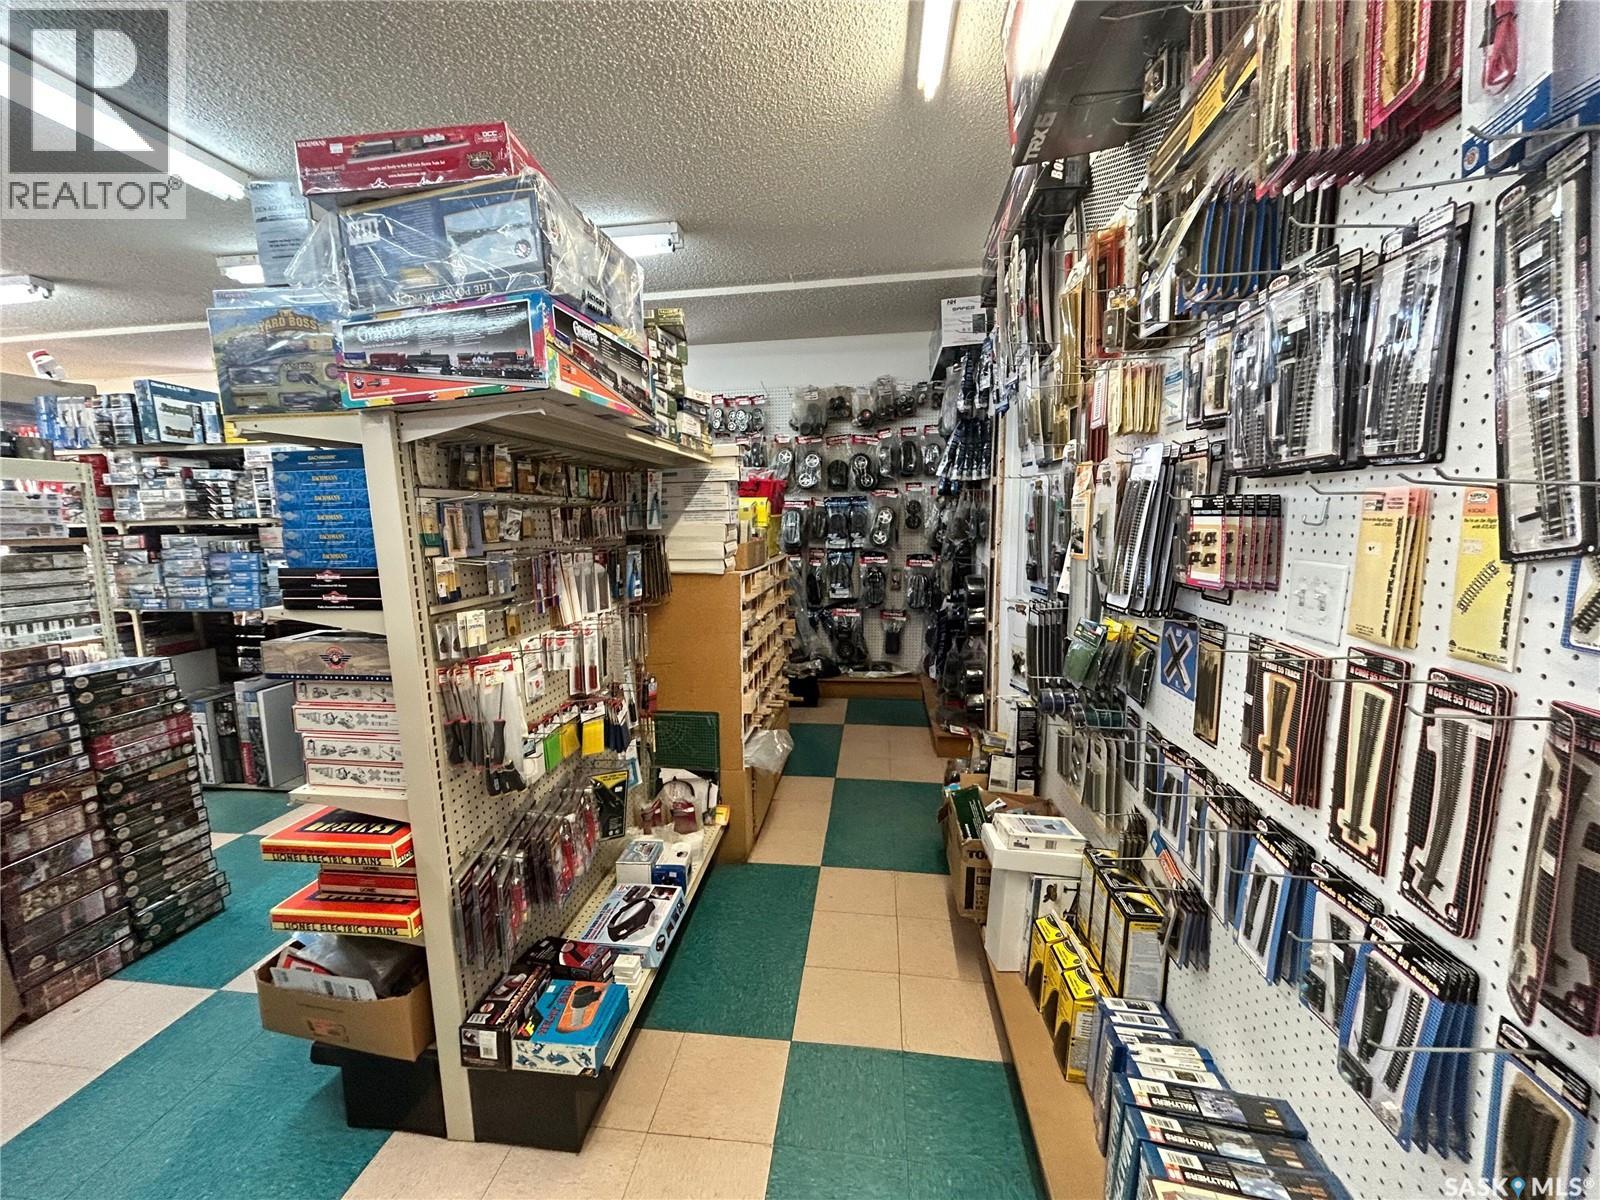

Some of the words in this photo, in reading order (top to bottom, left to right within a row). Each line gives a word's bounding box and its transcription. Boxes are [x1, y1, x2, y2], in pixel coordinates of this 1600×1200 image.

[260, 317, 286, 333] YARD
[288, 316, 318, 330] BOSS
[1267, 662, 1278, 672] CODE
[1285, 667, 1301, 680] TRACK
[1356, 667, 1369, 678] CODE
[1434, 687, 1452, 702] CODE
[1453, 692, 1464, 705] 55
[1464, 697, 1493, 716] TRACK
[272, 853, 305, 863] LIONEL
[307, 855, 347, 865] ELECTRIC
[350, 856, 382, 866] TRAINS
[1275, 850, 1290, 868] Switch
[1320, 881, 1337, 897] Code
[1337, 893, 1347, 905] 80
[1347, 901, 1371, 922] Switch
[283, 922, 316, 932] LIONEL
[320, 923, 359, 933] ELECTRIC
[366, 925, 398, 936] TRAINS
[1397, 955, 1409, 970] 80
[1409, 966, 1440, 996] Switch
[1152, 1097, 1200, 1113] WALTHERS
[1166, 1133, 1215, 1151] WALTHERS
[1185, 1172, 1239, 1190] WALTHERS
